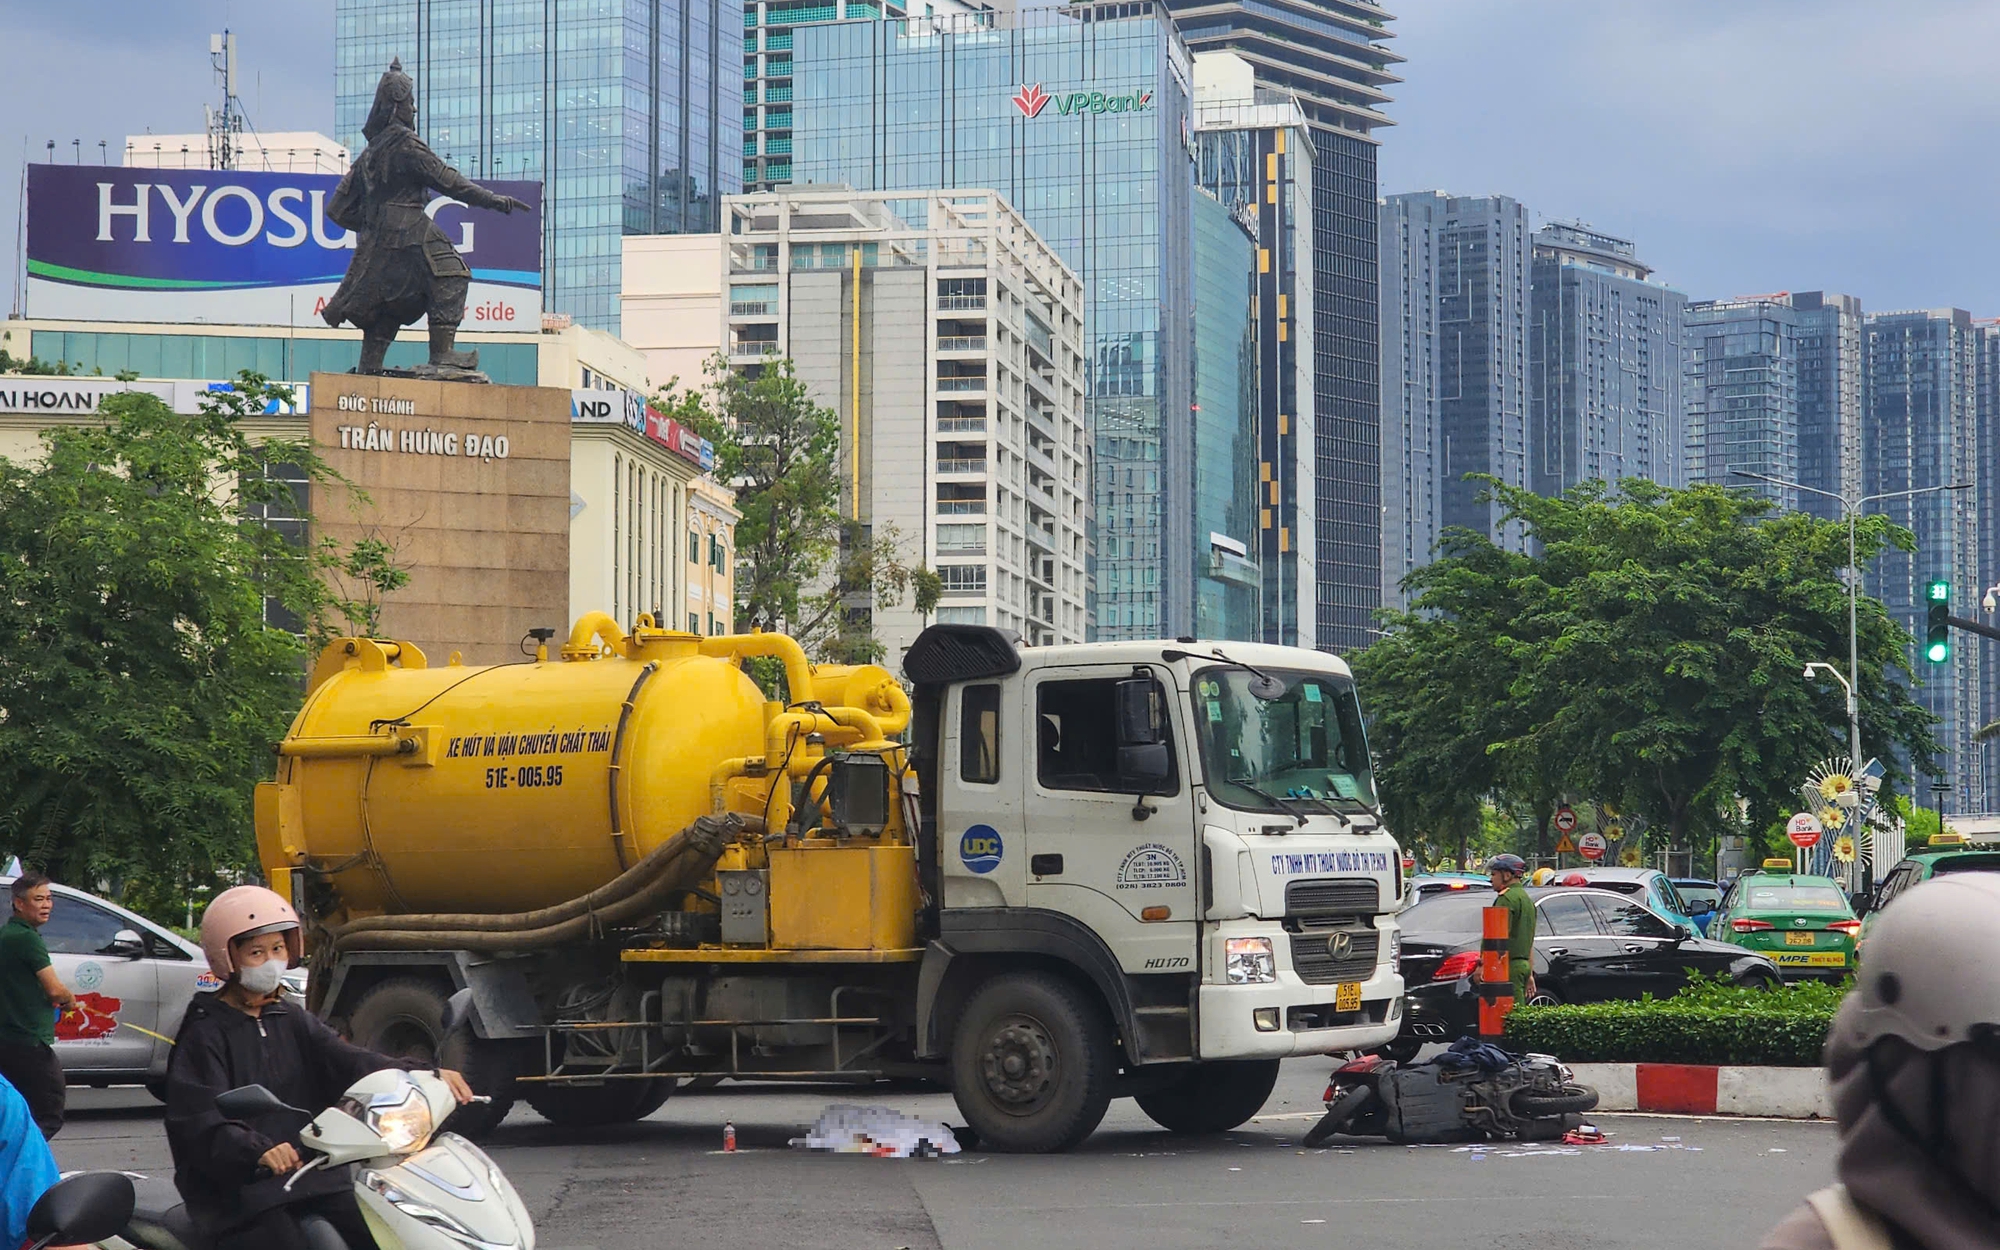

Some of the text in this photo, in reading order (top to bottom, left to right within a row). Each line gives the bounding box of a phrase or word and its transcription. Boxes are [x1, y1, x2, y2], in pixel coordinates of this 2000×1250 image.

[1054, 89, 1152, 116] VPBank
[95, 182, 475, 254] HYOSUG
[475, 301, 516, 321] side
[23, 391, 92, 409] HOAN
[338, 393, 415, 415] ĐỨC THÁNH
[338, 421, 509, 463] TRẦN HƯNG ĐẠO
[446, 737, 461, 758] XE
[461, 732, 482, 757] HÚT
[483, 732, 497, 757] VÀ
[518, 725, 560, 755] CHUYỂN
[560, 724, 586, 753] CHẤT
[587, 724, 611, 752] THẢI
[485, 767, 508, 788] 51E
[518, 765, 563, 787] 005.95
[964, 838, 998, 854] UDC
[1272, 855, 1284, 874] CTY
[1304, 854, 1317, 873] MTV
[1779, 955, 1810, 963] MPE
[1343, 984, 1354, 996] 51E
